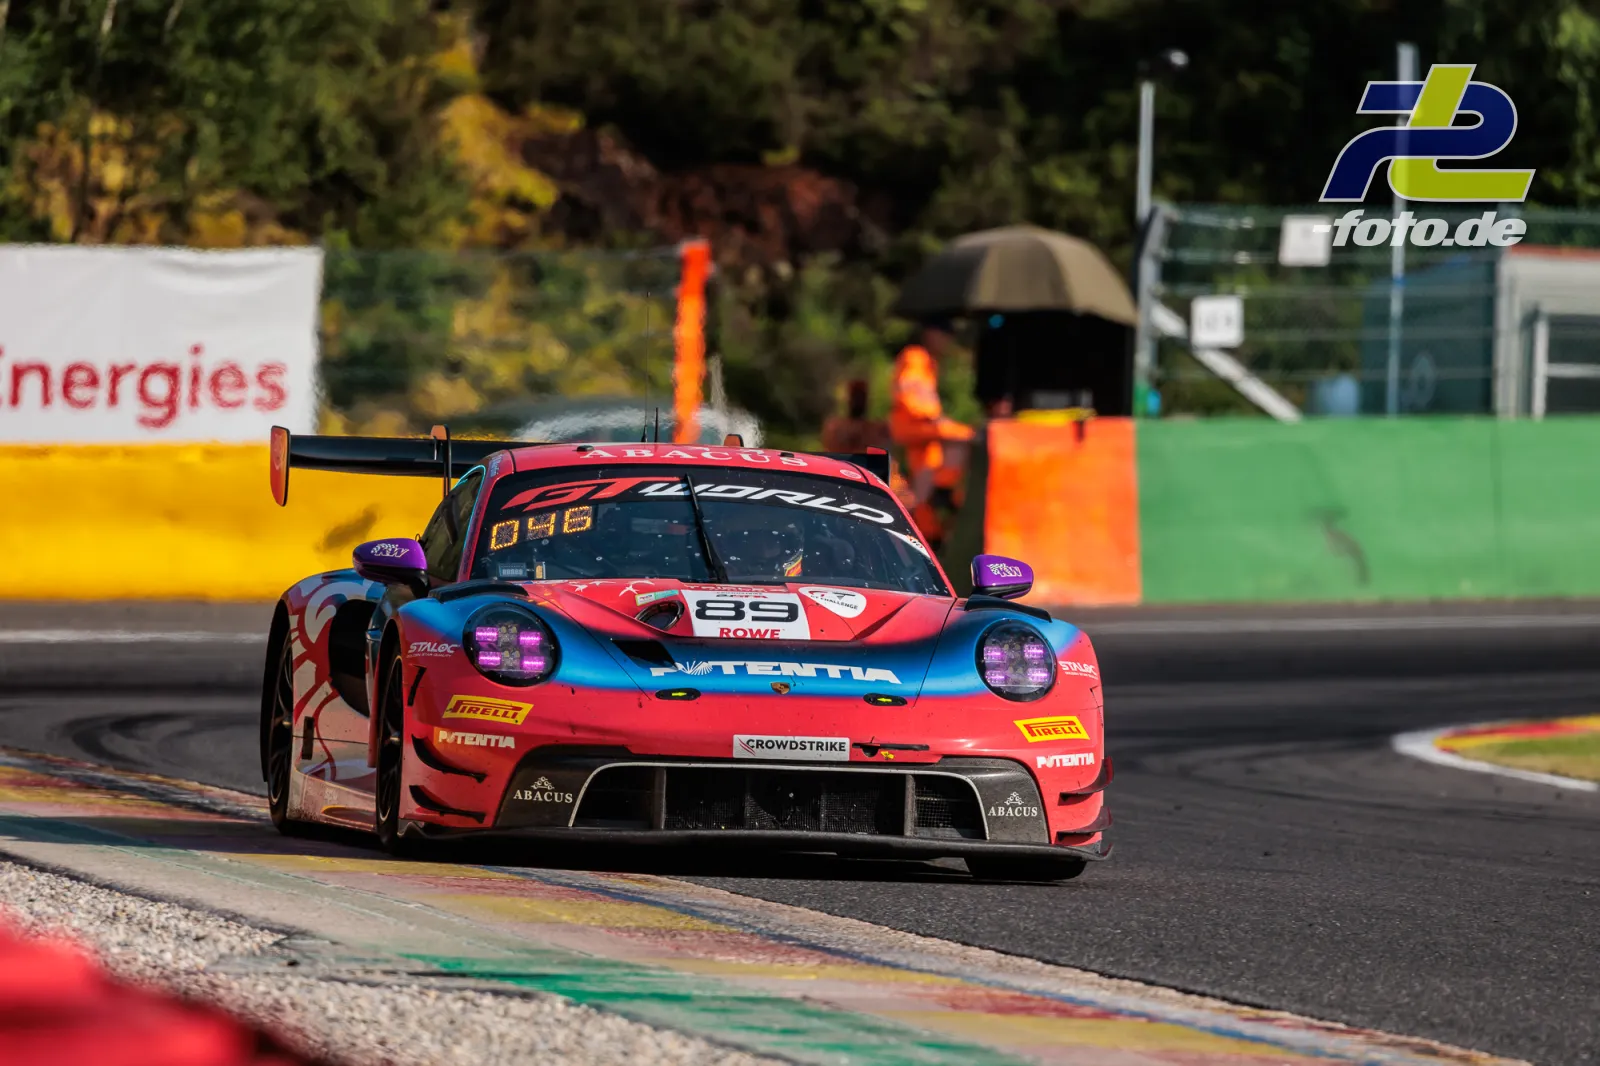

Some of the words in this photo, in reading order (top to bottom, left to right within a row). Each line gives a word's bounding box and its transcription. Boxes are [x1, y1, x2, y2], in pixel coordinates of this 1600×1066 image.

[0, 343, 288, 428] nergies
[579, 448, 808, 467] ABACUS
[489, 504, 593, 551] 046
[695, 600, 799, 622] 89
[719, 627, 781, 639] ROWE
[408, 641, 458, 654] STALOC
[1058, 660, 1098, 676] STALOC
[452, 700, 523, 719] PIRELLI
[1023, 720, 1082, 738] PIRELLI
[746, 739, 847, 752] CROWDSTRIKE
[513, 789, 573, 803] ABACUS
[987, 806, 1038, 817] ABACUS
